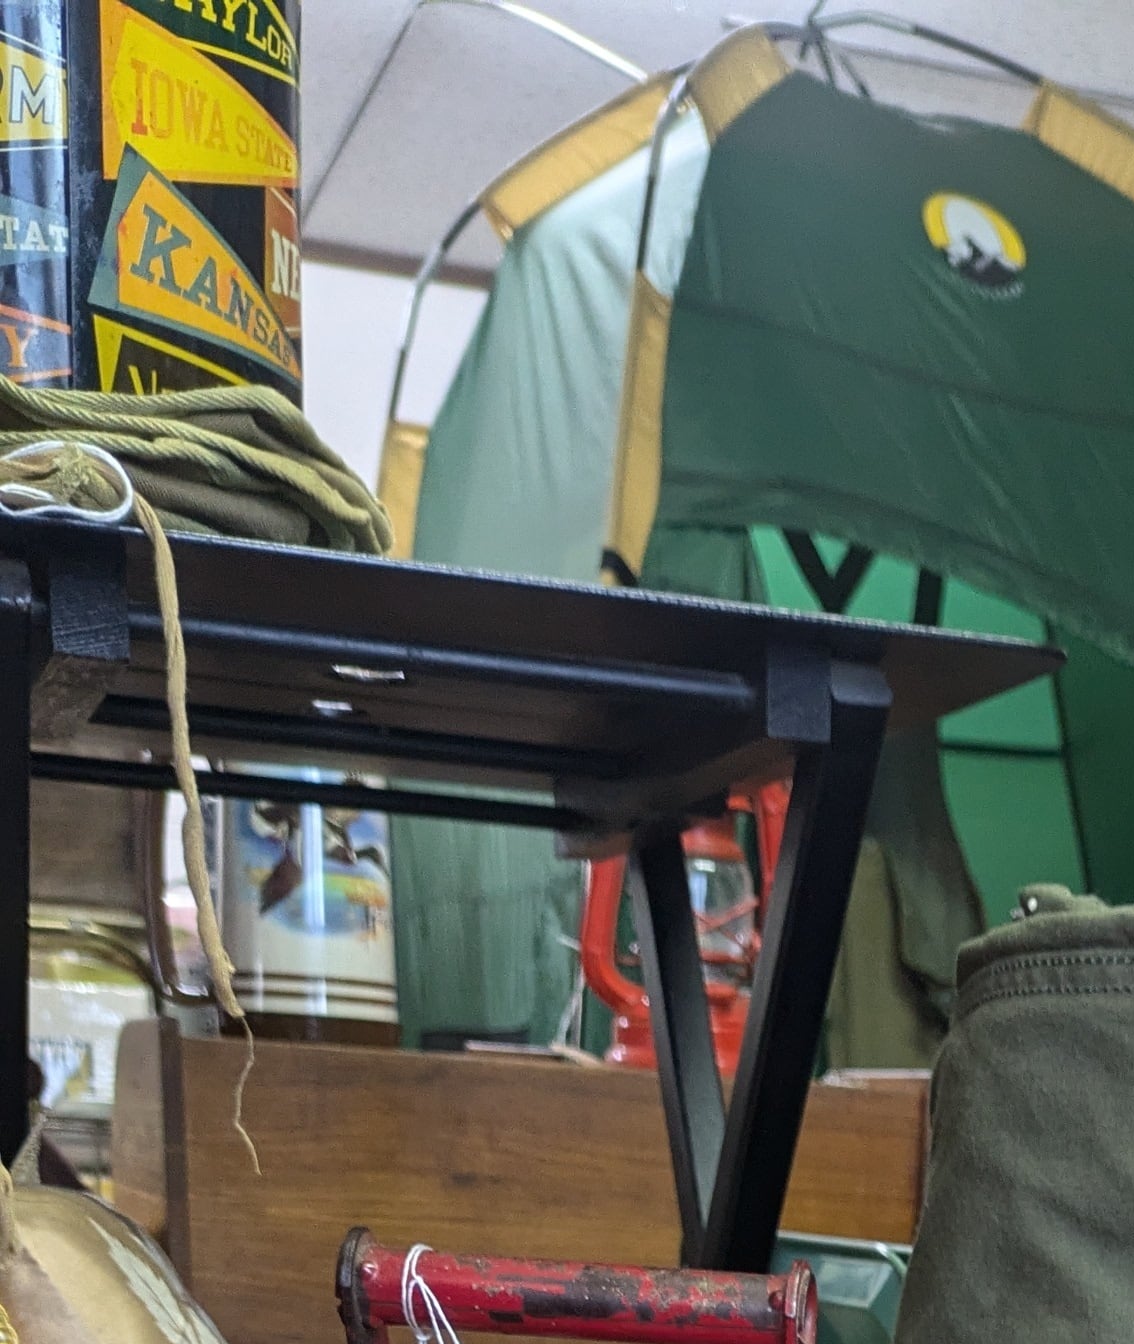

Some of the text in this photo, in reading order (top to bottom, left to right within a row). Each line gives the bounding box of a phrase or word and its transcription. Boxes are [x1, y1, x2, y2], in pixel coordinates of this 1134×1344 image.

[131, 57, 293, 172] IOWA STATE
[129, 204, 292, 365] KANSAS
